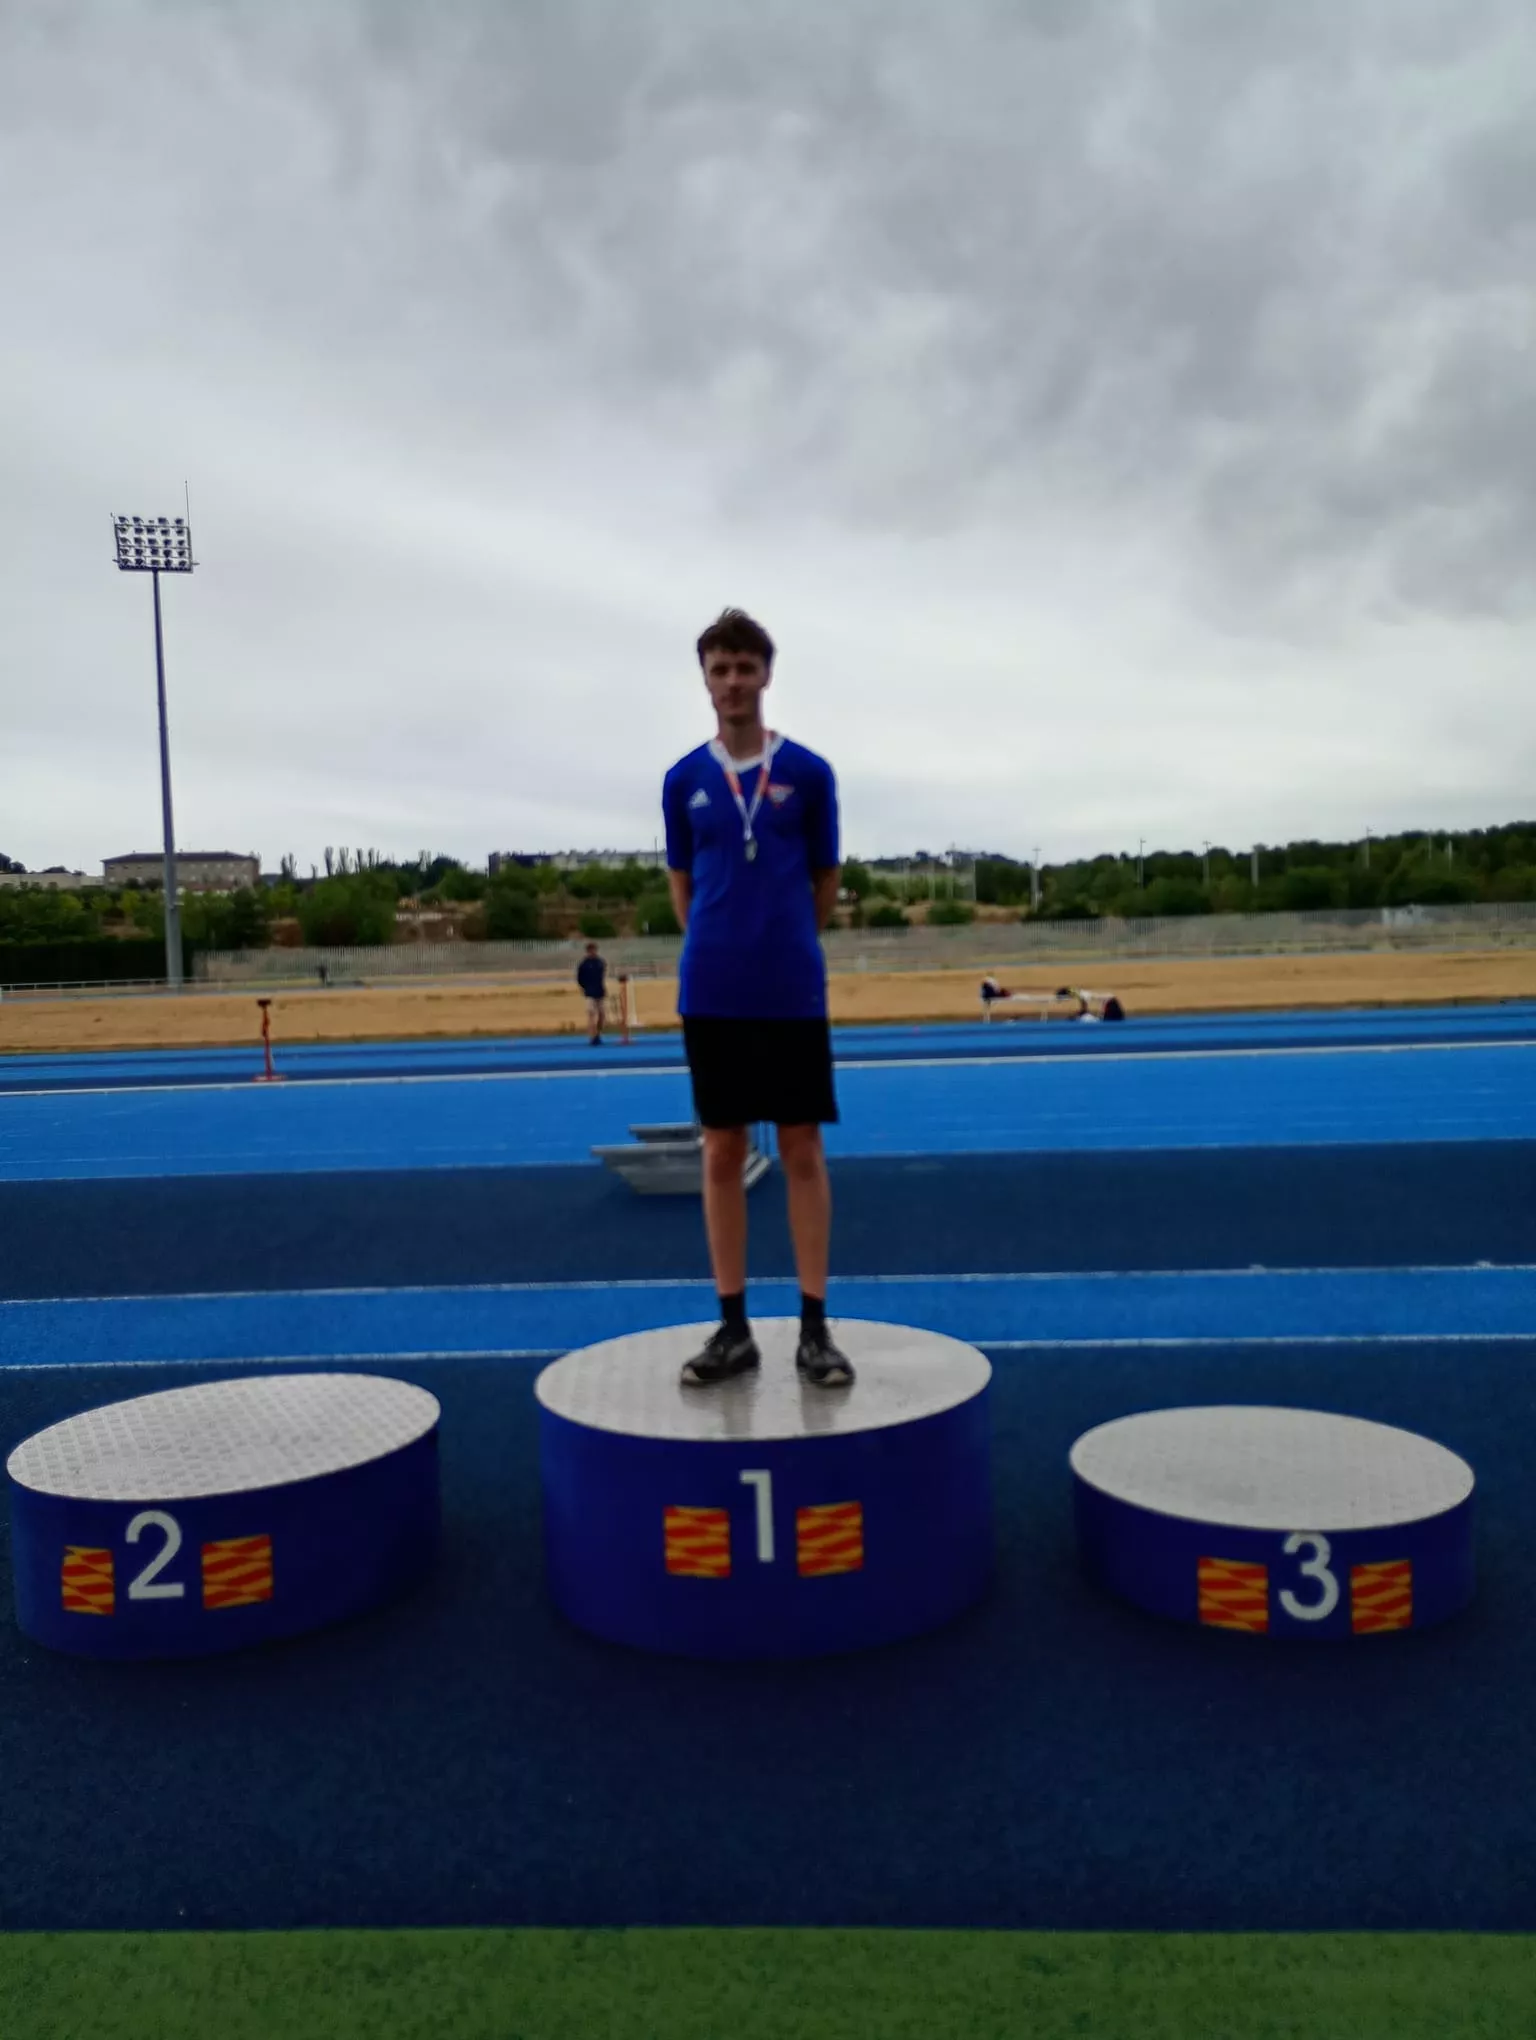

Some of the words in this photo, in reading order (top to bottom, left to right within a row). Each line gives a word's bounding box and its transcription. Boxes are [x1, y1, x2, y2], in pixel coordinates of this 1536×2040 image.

[126, 1510, 184, 1600] 2
[740, 1470, 774, 1562] 1
[1279, 1532, 1339, 1621] 3
